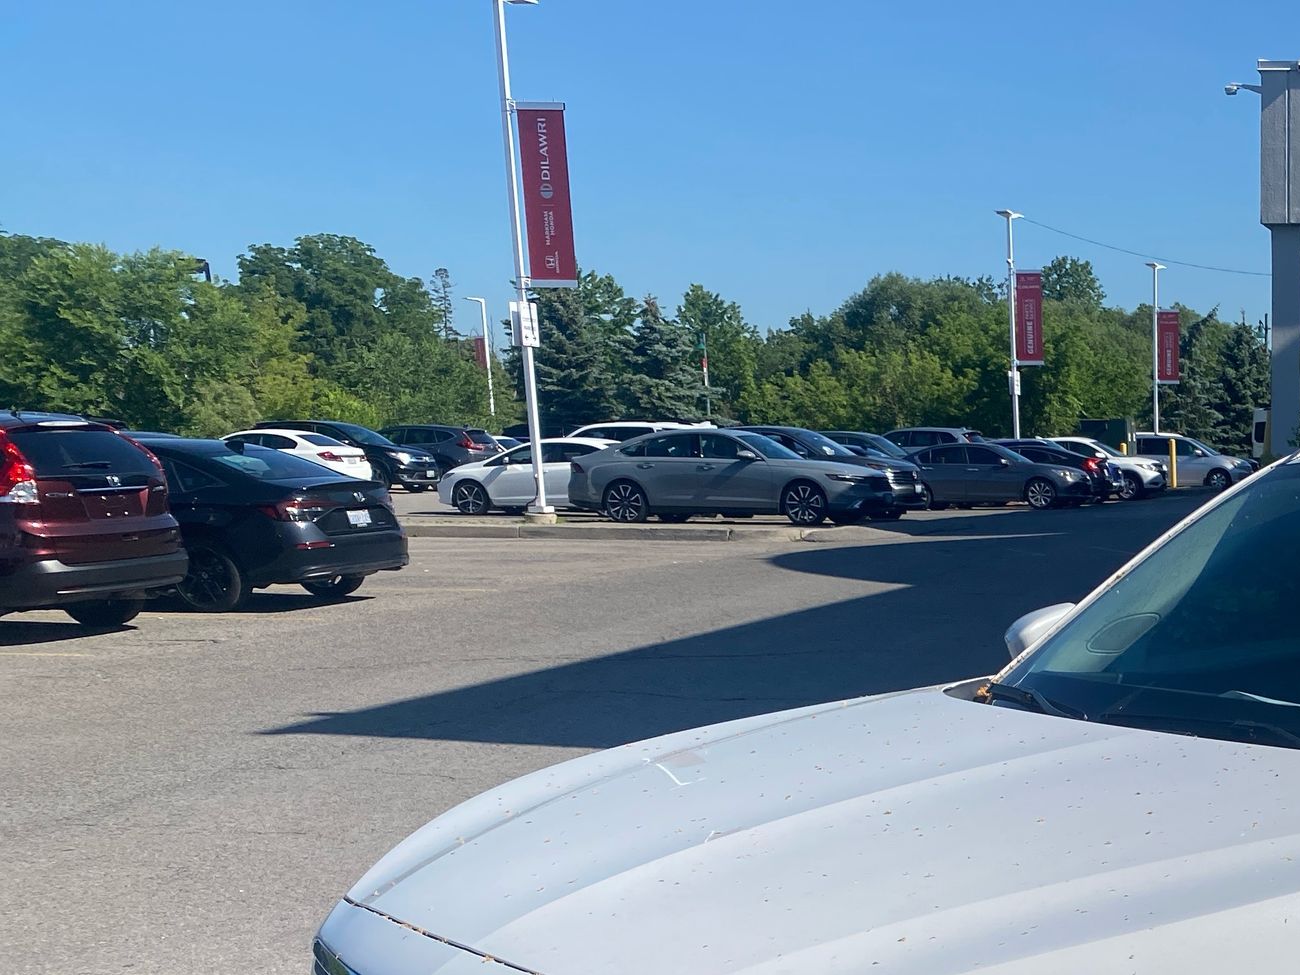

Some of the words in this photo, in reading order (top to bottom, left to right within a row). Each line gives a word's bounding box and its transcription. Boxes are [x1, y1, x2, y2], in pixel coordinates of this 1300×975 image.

[537, 118, 550, 180] DILAWRI
[543, 211, 551, 246] MARKHAM
[1026, 321, 1034, 354] GENUINE
